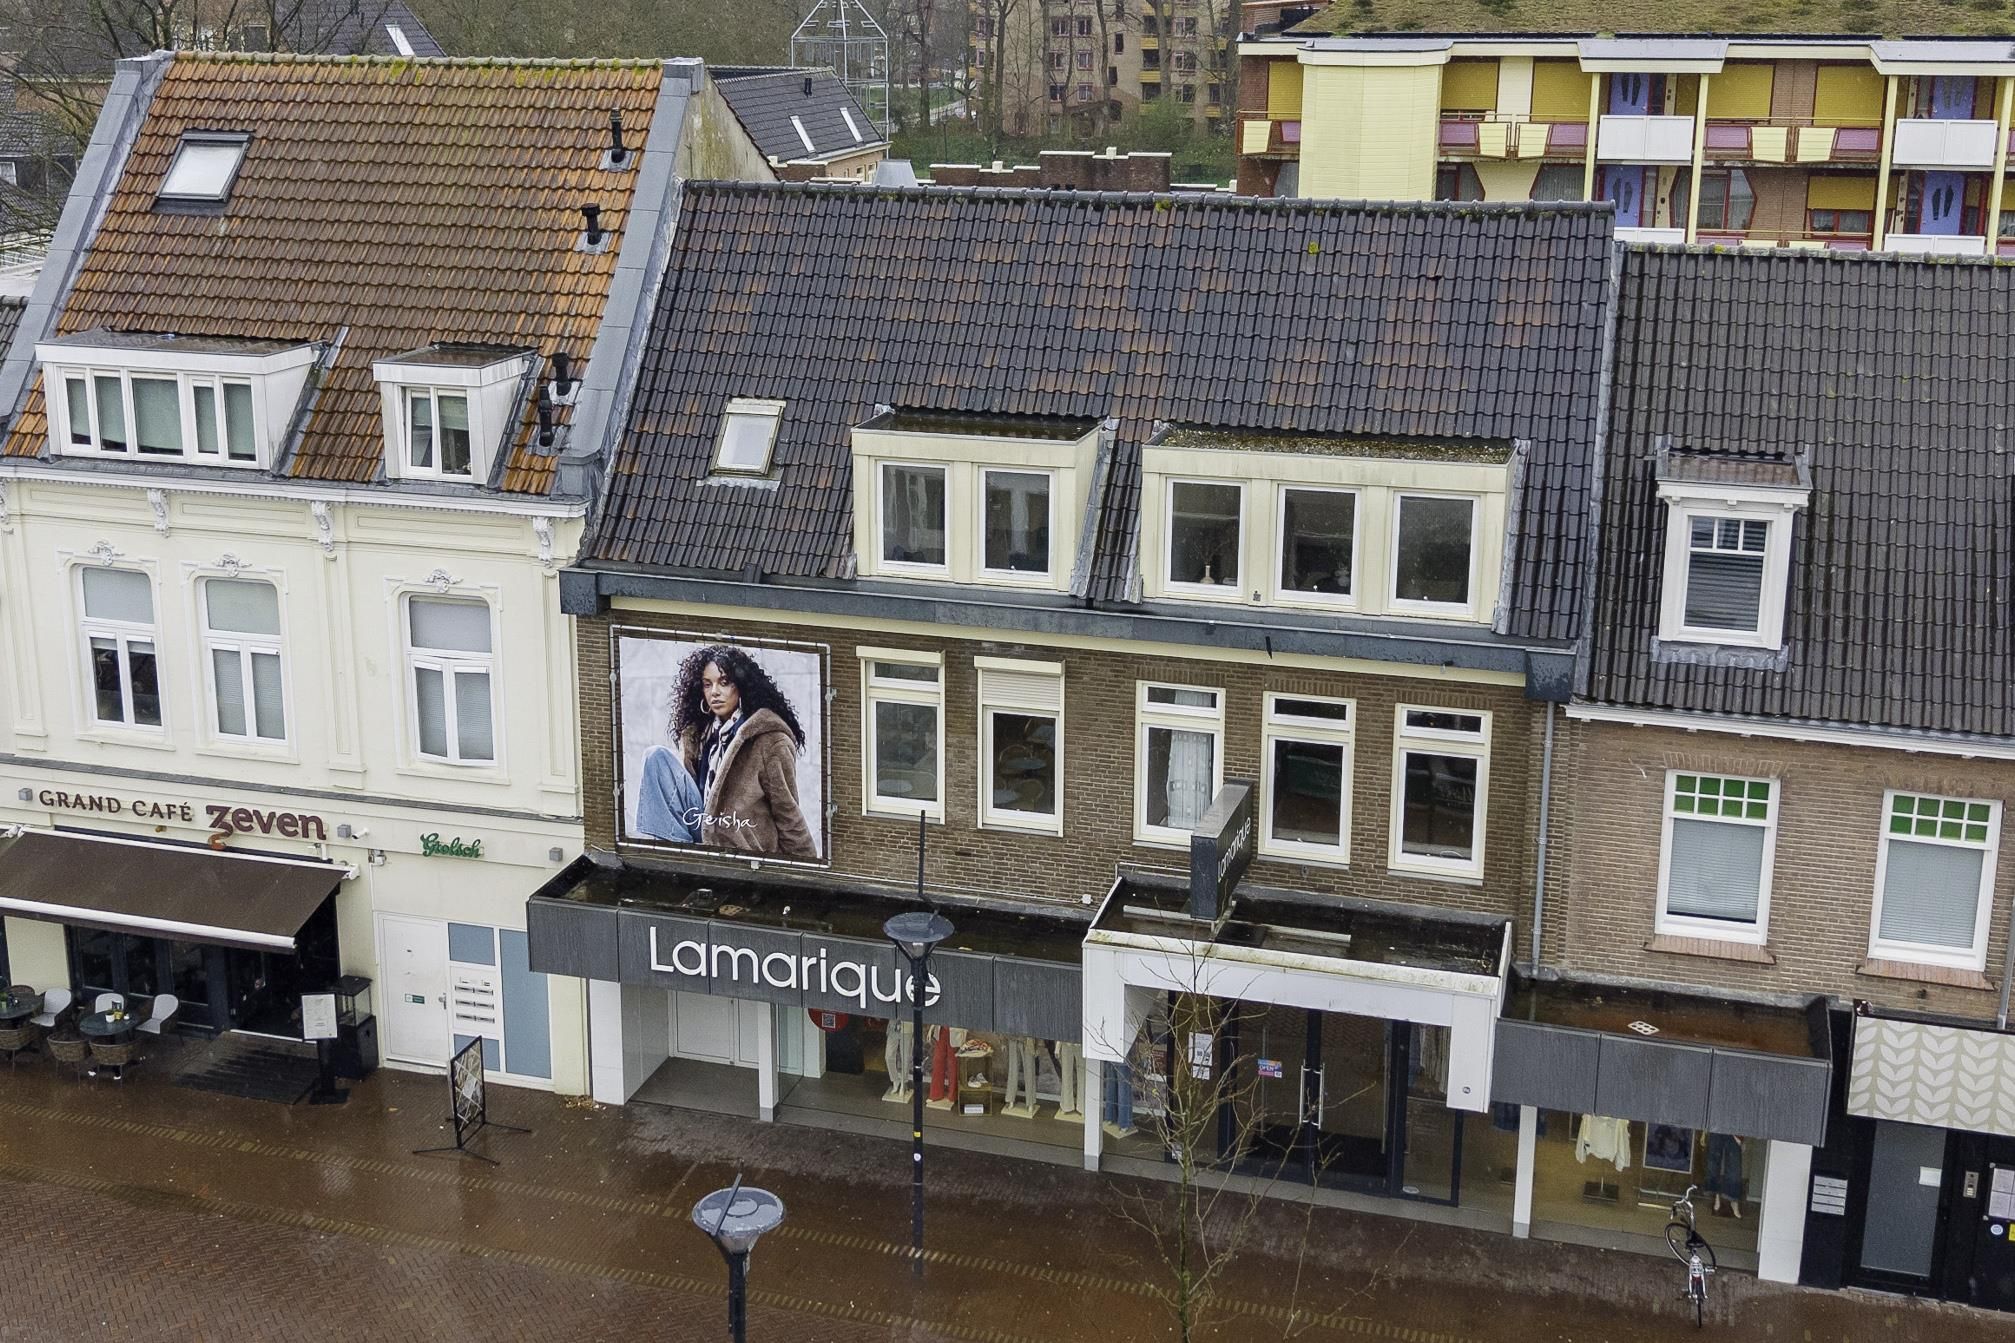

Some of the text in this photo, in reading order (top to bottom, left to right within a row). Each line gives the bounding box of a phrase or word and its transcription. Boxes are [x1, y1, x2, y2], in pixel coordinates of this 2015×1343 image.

[38, 788, 122, 814] GRAND
[131, 799, 194, 823] CAFÉ
[682, 806, 758, 833] Geisha
[420, 832, 481, 859] Grolsch
[1217, 817, 1251, 884] Lamarique
[648, 926, 942, 1009] Lamarique
